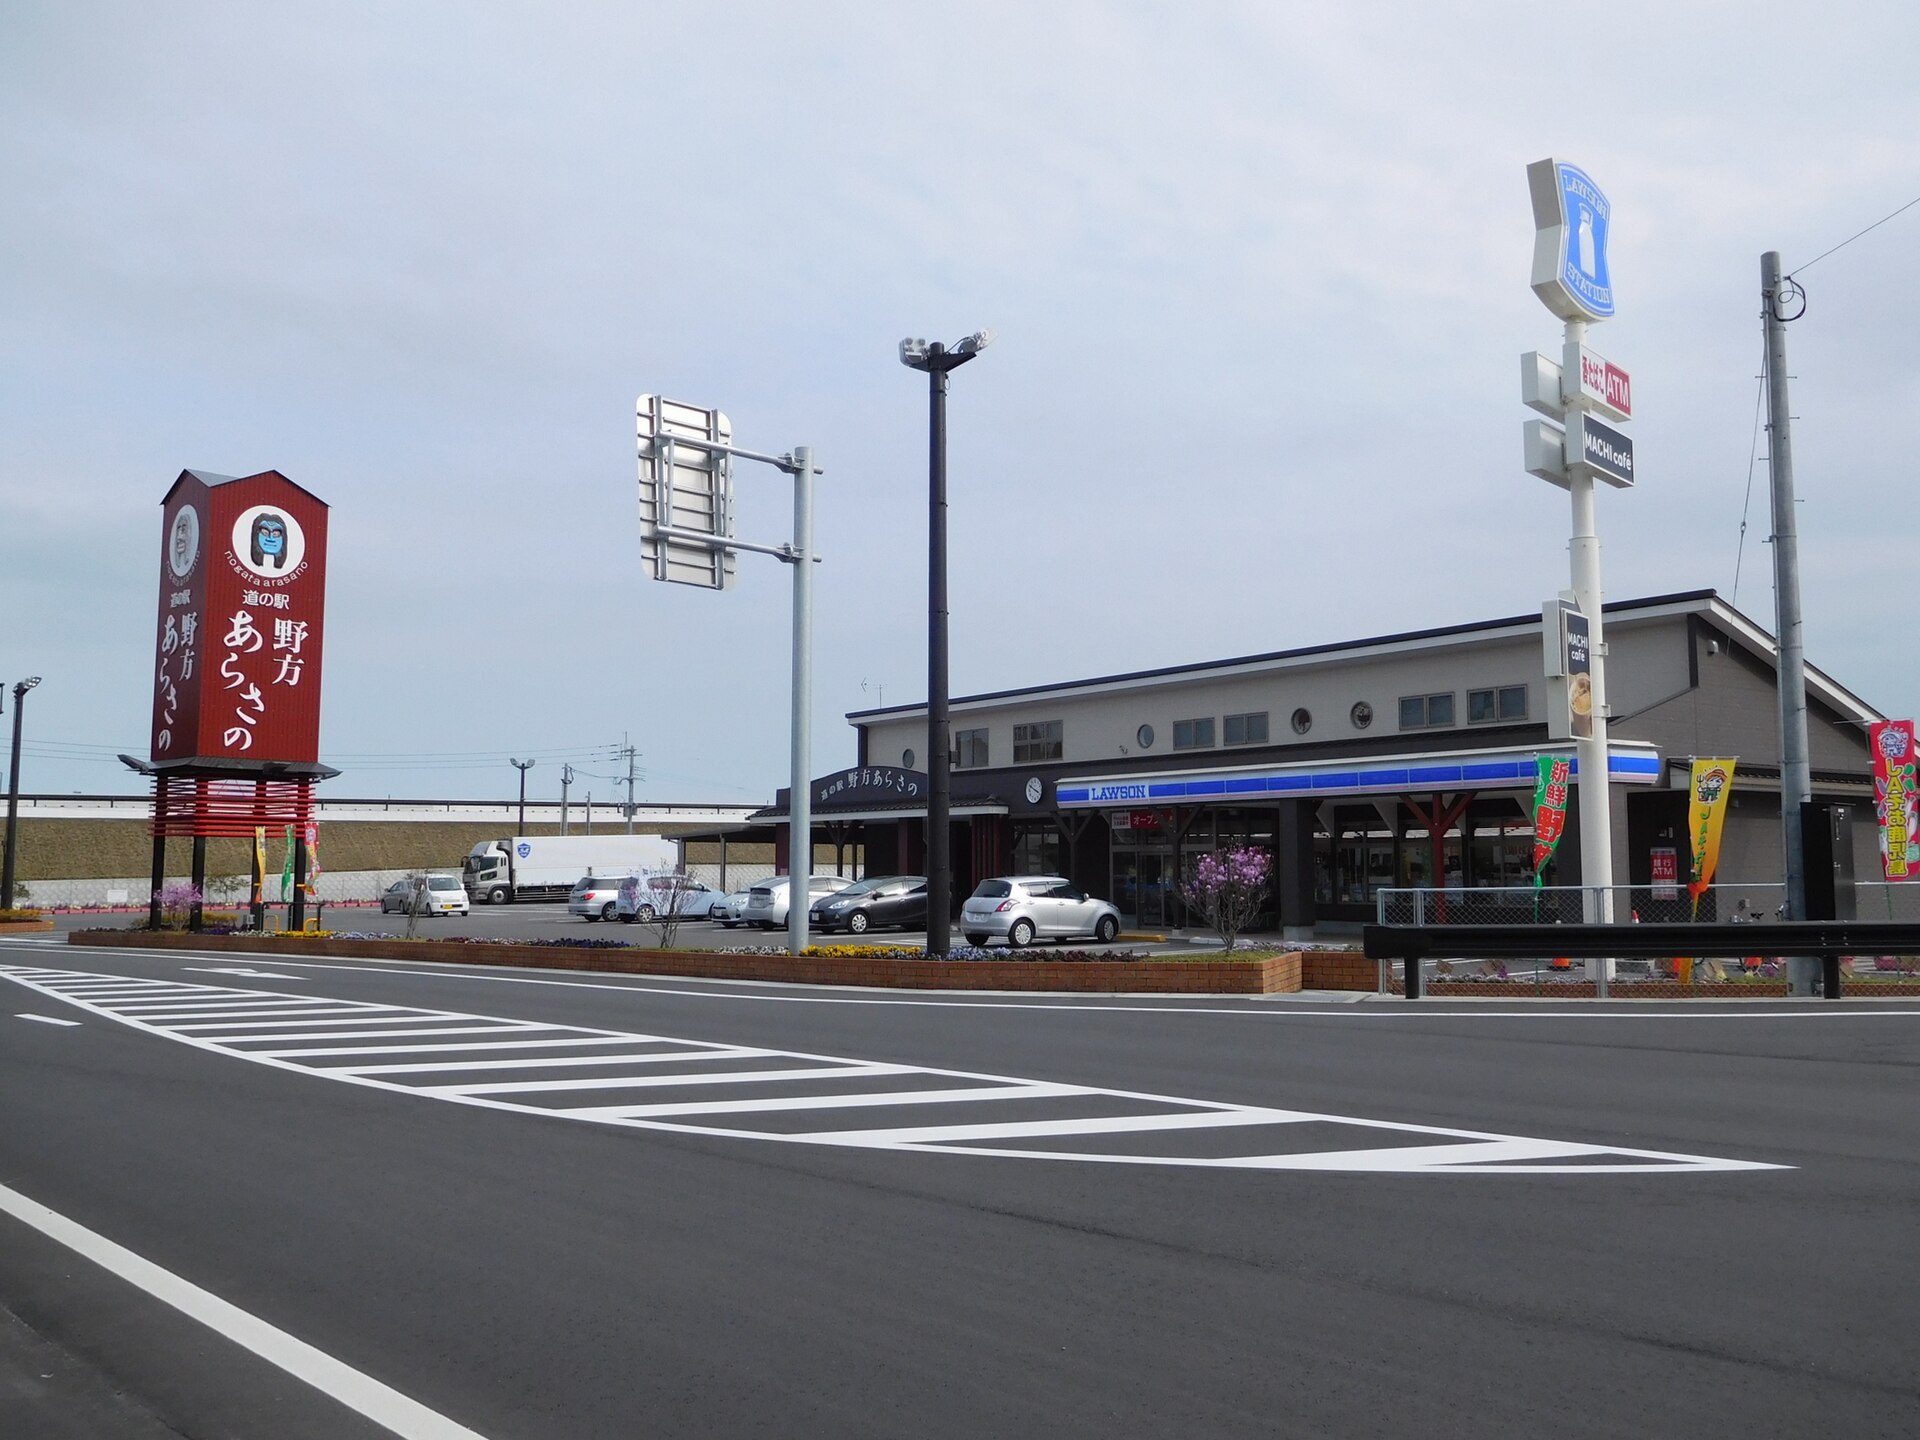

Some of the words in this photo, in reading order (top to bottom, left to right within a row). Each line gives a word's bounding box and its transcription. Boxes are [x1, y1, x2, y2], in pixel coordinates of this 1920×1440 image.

[1562, 174, 1608, 221] LAWSON
[1567, 261, 1611, 304] STATION
[1606, 371, 1630, 408] ATM
[1584, 431, 1613, 462] MACHI
[1613, 451, 1632, 471] café
[224, 550, 261, 587] nogata
[263, 561, 309, 587] arasano
[242, 589, 290, 610] 道の駅
[180, 611, 198, 682] 野方
[272, 618, 309, 687] 野方
[1567, 631, 1589, 650] MACHI
[1571, 649, 1586, 662] café
[158, 614, 179, 752] あらさの
[220, 610, 266, 751] あらさの
[820, 780, 845, 802] 道の駅
[847, 768, 918, 798] 野方あらさの
[1090, 784, 1147, 801] LAWSON
[1652, 867, 1673, 876] ATM
